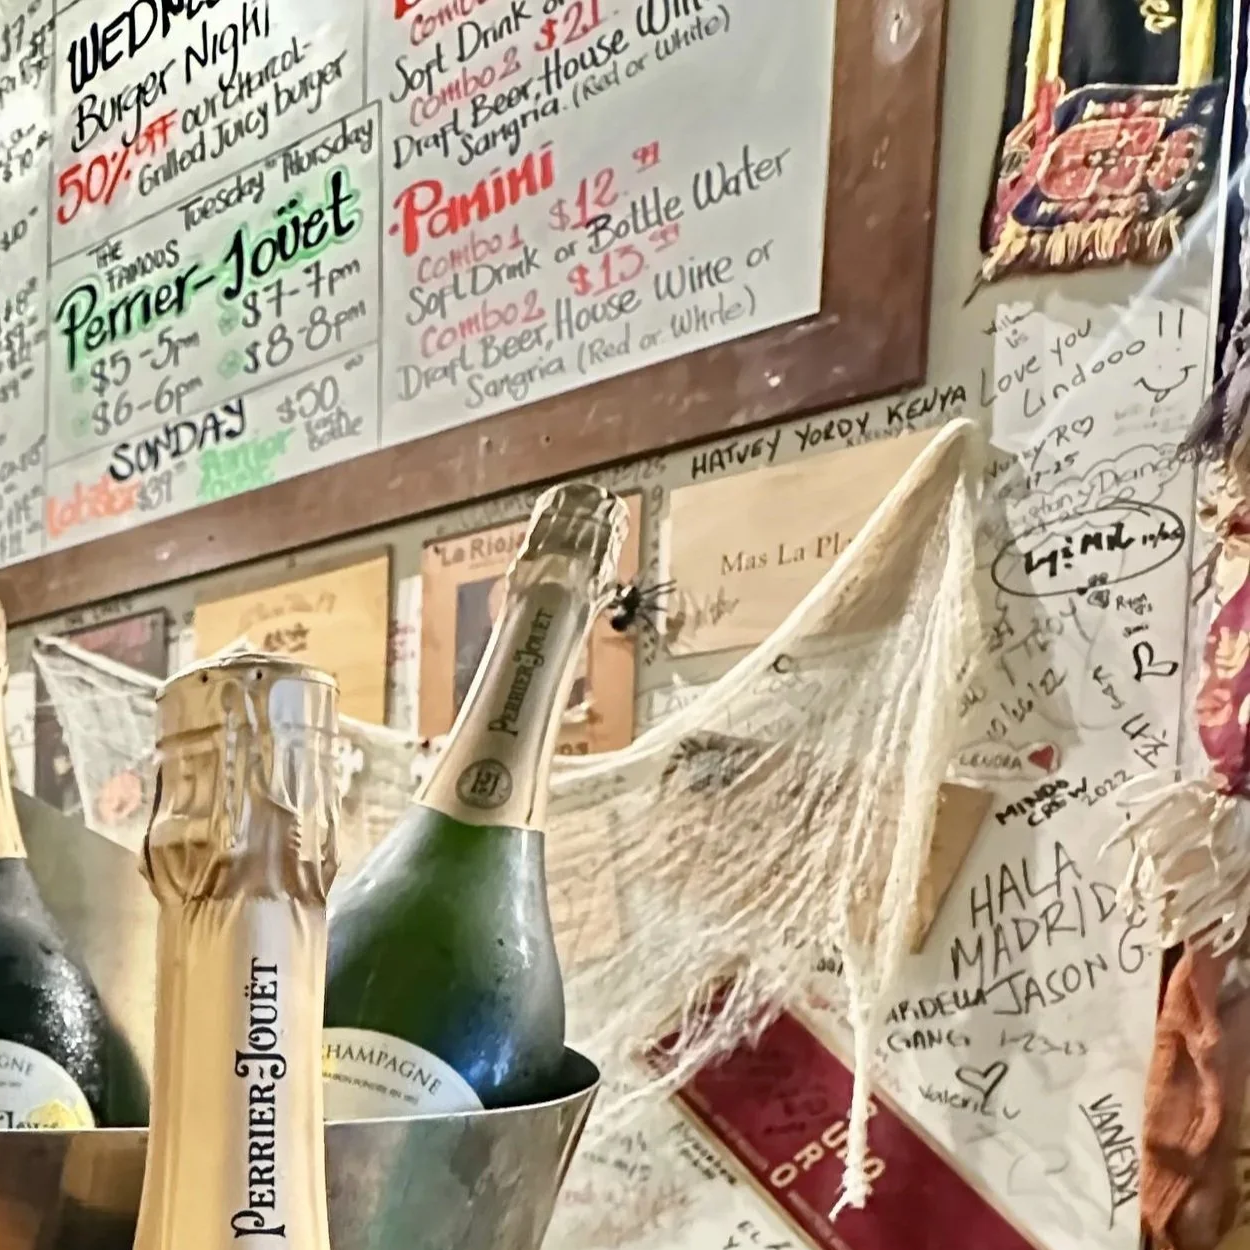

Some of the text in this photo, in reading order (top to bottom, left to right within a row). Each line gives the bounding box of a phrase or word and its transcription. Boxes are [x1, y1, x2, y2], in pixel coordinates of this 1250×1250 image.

[456, 0, 533, 63] Drink
[625, 51, 650, 79] or
[70, 59, 177, 153] Burger
[182, 92, 219, 135] our
[211, 100, 269, 160] Juicy
[274, 49, 348, 116] burger
[393, 105, 463, 169] Draft
[544, 28, 630, 94] House
[57, 149, 132, 225] 50%
[178, 170, 265, 231] Tuesday
[470, 245, 541, 295] Drink
[554, 239, 580, 264] or
[586, 186, 685, 255] Bottle
[692, 144, 791, 212] Water
[396, 352, 473, 402] Draft
[554, 288, 642, 343] House
[653, 254, 733, 302] Wine
[745, 238, 776, 269] or
[464, 285, 757, 410] Sangria (Red or White)
[886, 384, 968, 426] KENYA
[979, 355, 1041, 407] Love
[720, 531, 856, 577] Mas La Pl
[970, 841, 1082, 929] HALA
[949, 882, 1119, 990] MADRID
[983, 953, 1109, 1016] JASON
[322, 1042, 442, 1097] HAMPAGNE
